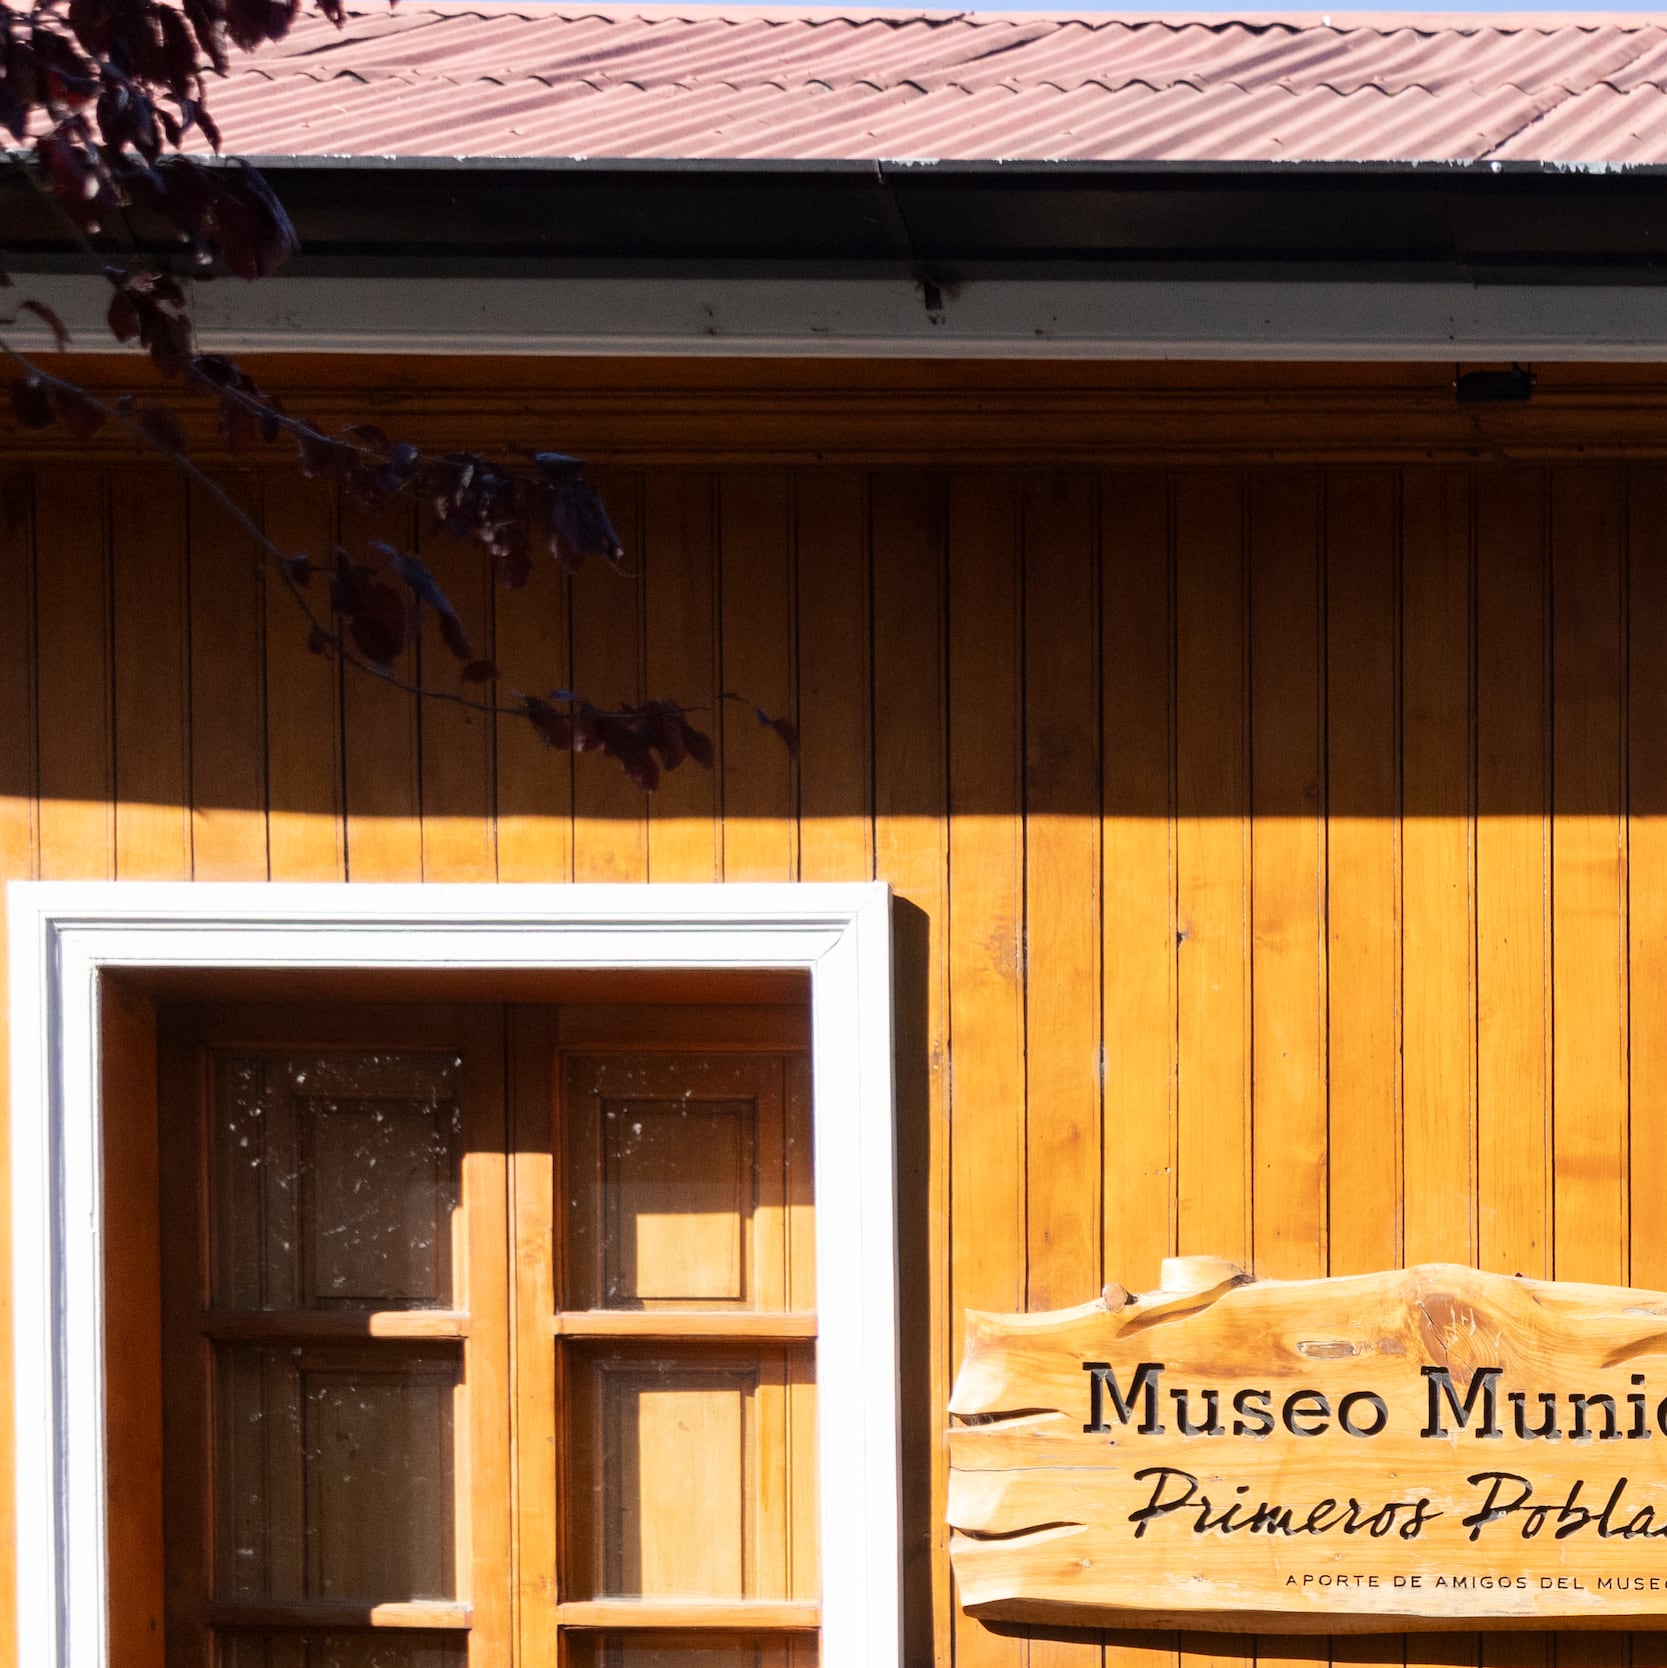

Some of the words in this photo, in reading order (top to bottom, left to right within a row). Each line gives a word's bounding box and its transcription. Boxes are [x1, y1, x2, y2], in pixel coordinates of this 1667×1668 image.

[1081, 1361, 1389, 1436] Museo
[1127, 1466, 1444, 1541] Primeros
[1286, 1574, 1380, 1588] APORTE
[1394, 1575, 1422, 1588] DE
[1436, 1576, 1527, 1589] AMIGOS
[1541, 1577, 1584, 1589] DEL
